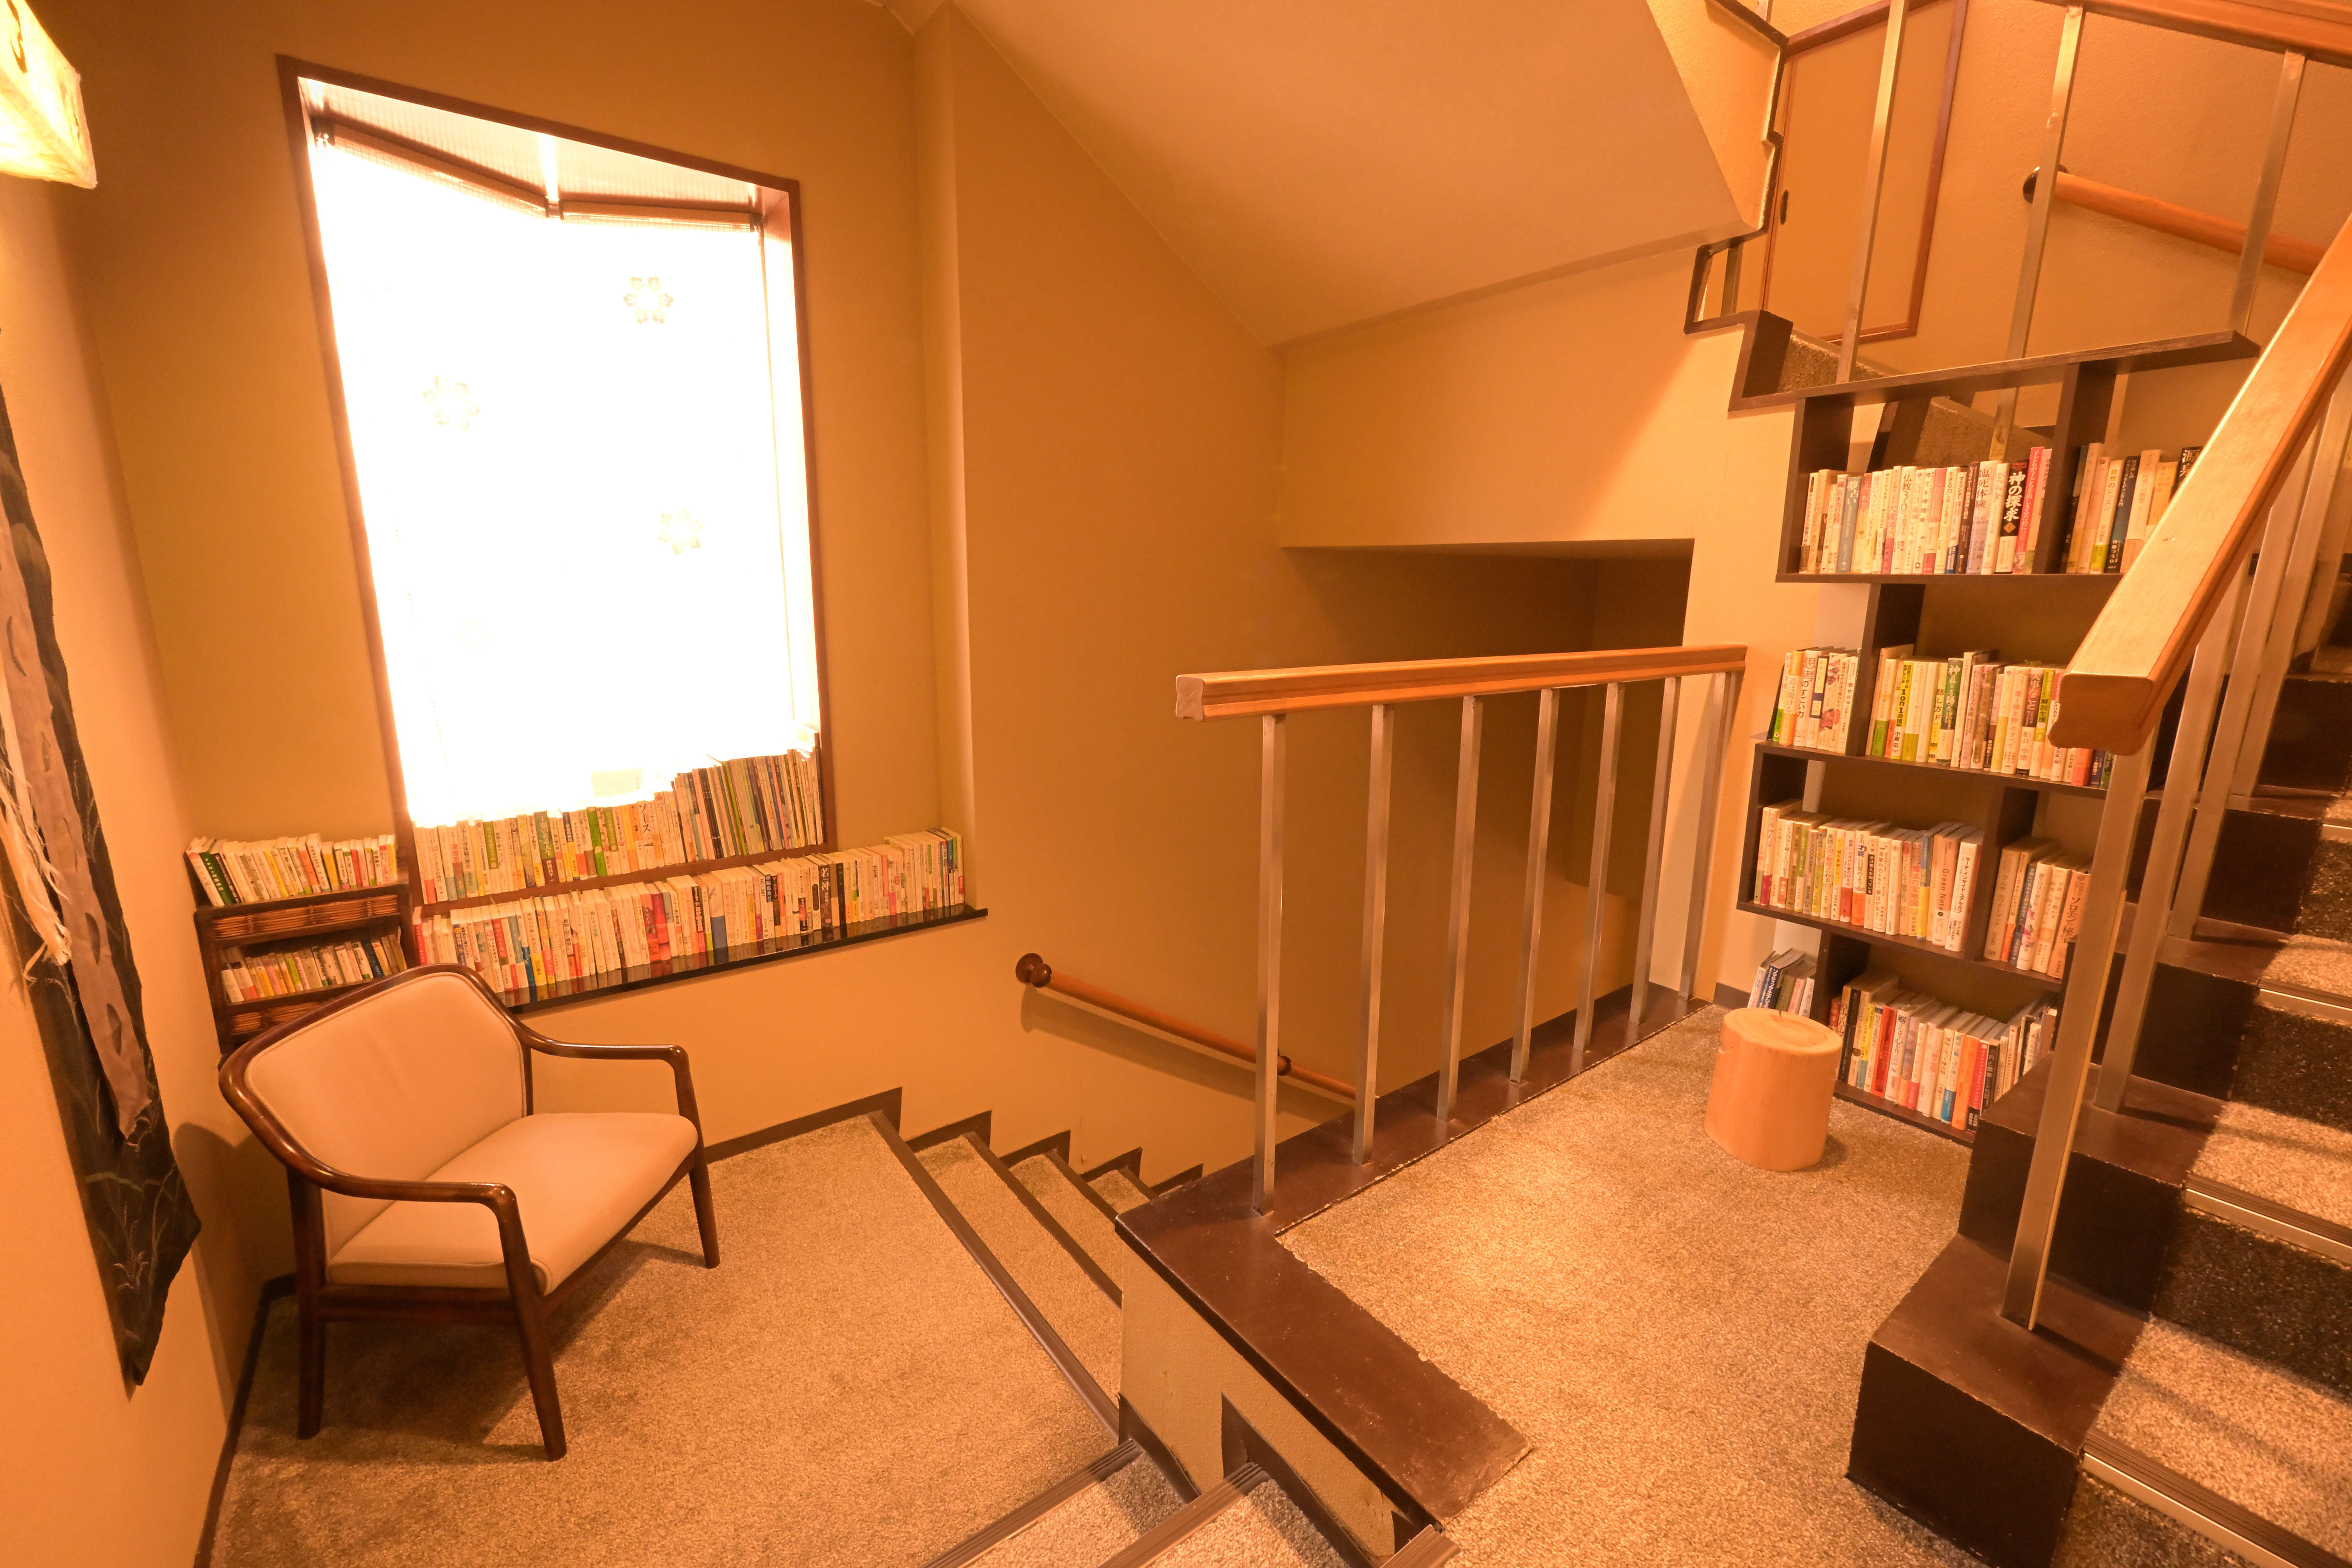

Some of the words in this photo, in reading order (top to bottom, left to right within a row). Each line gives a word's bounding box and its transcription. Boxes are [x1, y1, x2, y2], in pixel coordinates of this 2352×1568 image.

[1847, 480, 1860, 505] 夢占い
[1976, 468, 1990, 508] 臨死体験
[2004, 471, 2026, 522] 神の探求
[1786, 677, 1797, 713] 道は開ける
[1797, 657, 1816, 718] 思考のすごい力
[1895, 689, 1906, 727] 1on1の技術
[639, 803, 651, 833] ソース
[1941, 868, 1949, 891] Green
